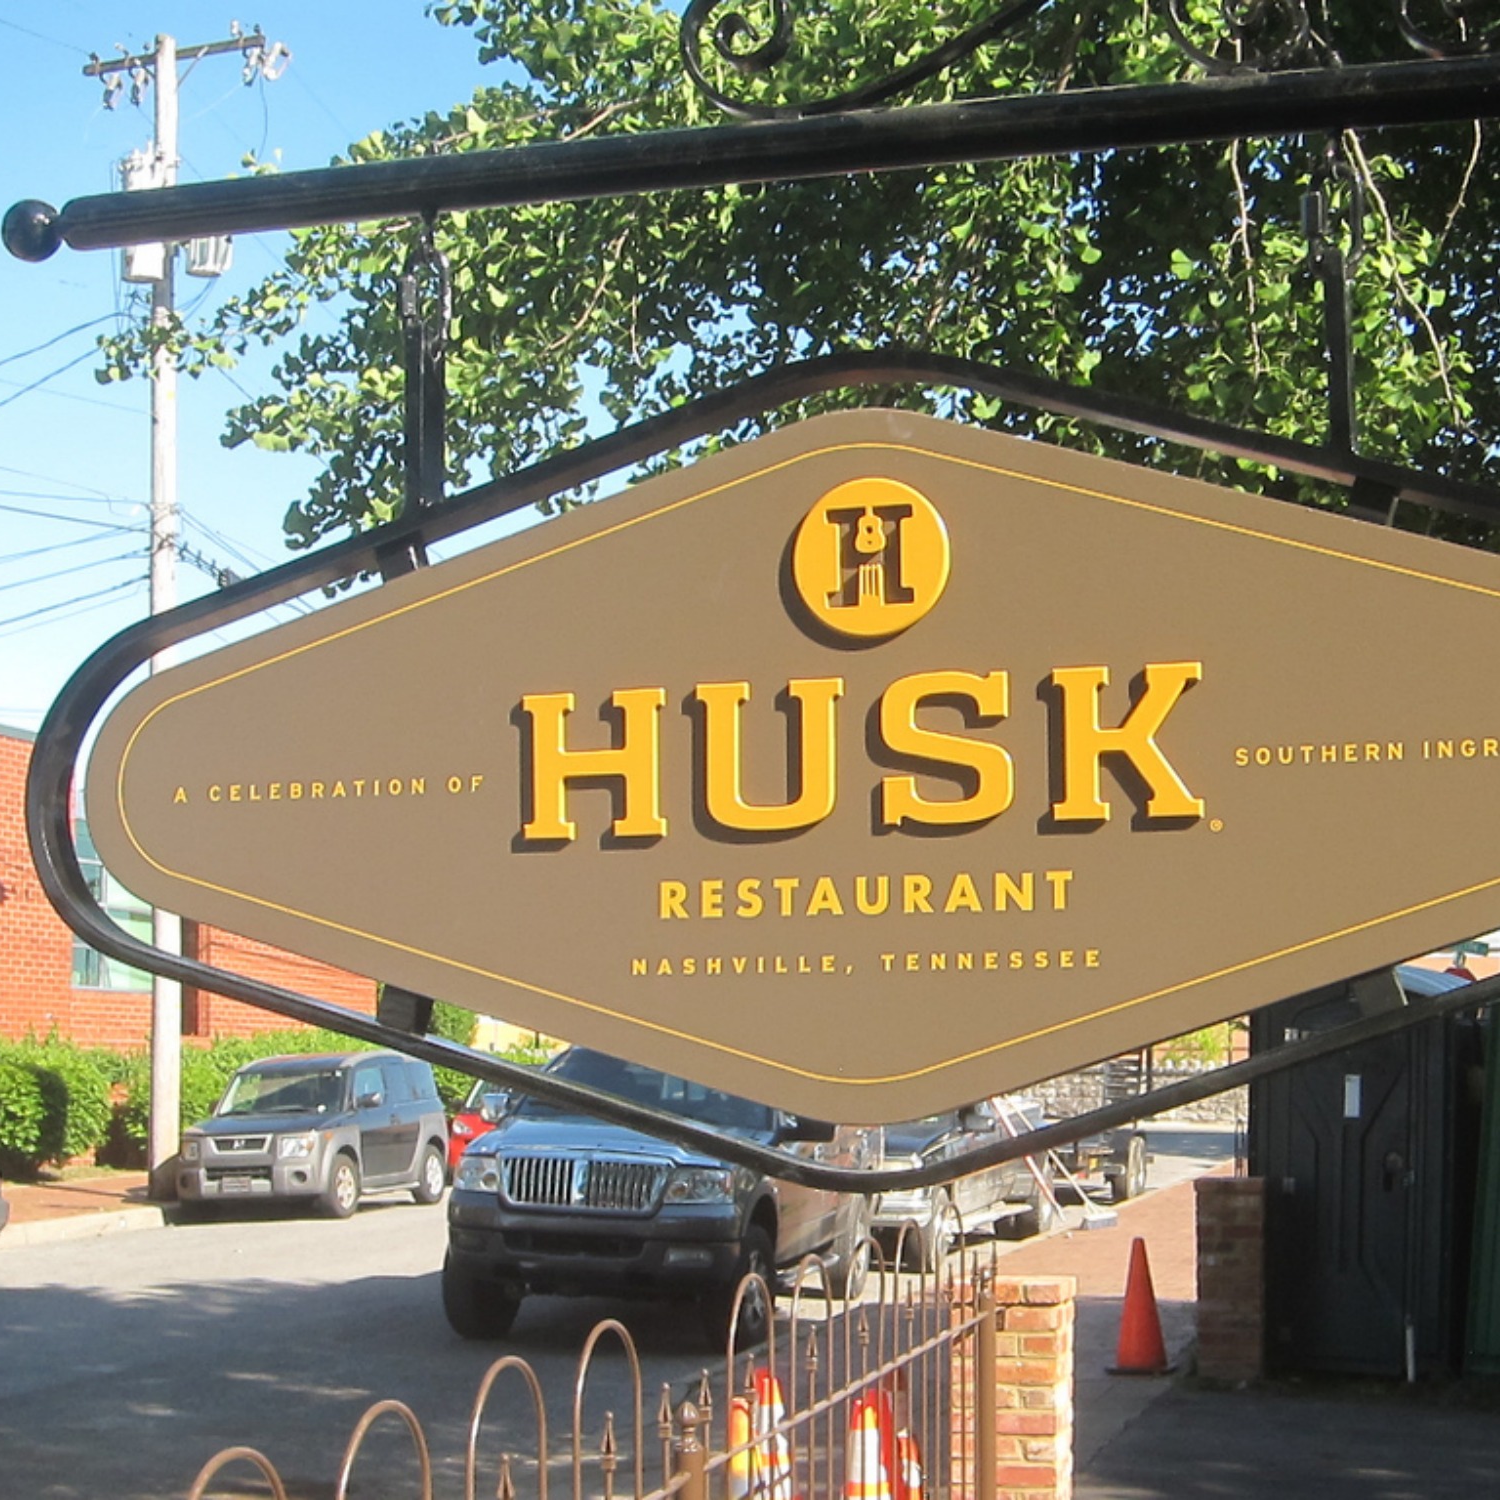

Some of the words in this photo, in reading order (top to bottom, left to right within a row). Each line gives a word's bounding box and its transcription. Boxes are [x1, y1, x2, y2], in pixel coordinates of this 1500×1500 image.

[825, 503, 915, 609] H
[521, 661, 1206, 841] HUSK
[1235, 742, 1404, 767] SOUTHERN
[173, 786, 188, 803] A
[209, 777, 426, 802] CELEBRATION
[446, 775, 485, 795] OF
[659, 870, 1073, 920] RESTAURANT
[632, 954, 853, 976] NASHVILLE,
[881, 948, 1101, 972] TENNESSEE
